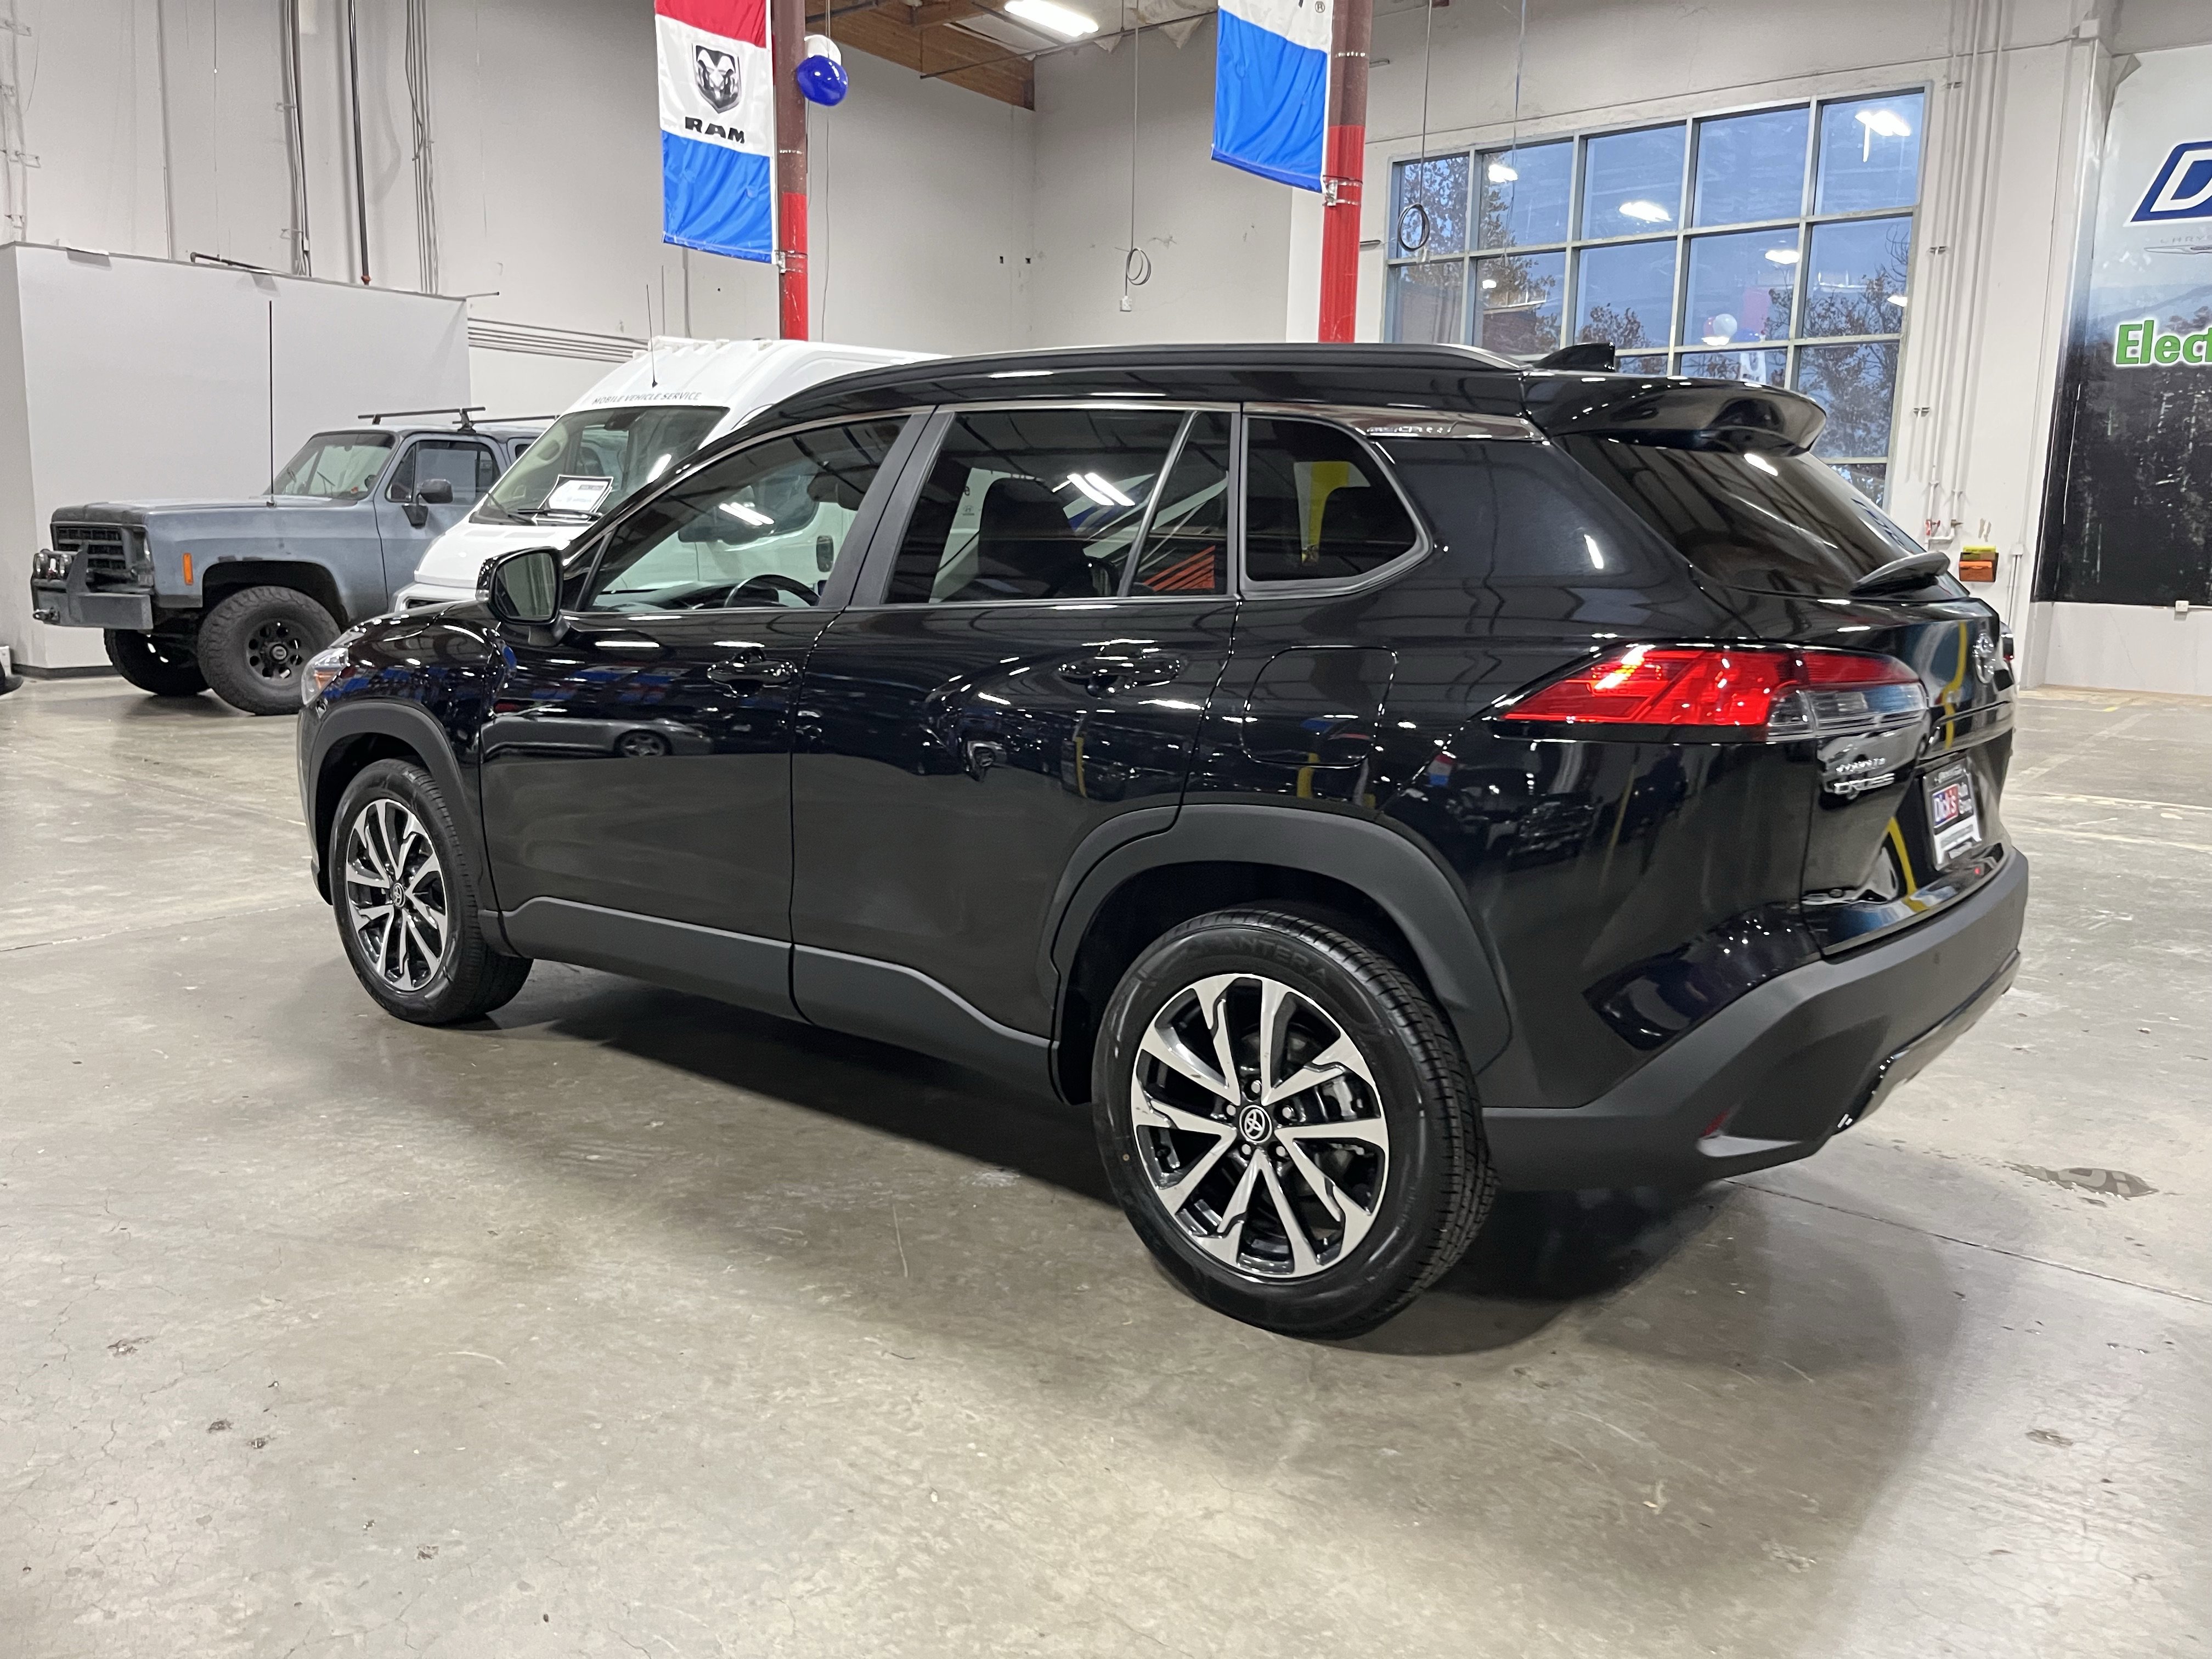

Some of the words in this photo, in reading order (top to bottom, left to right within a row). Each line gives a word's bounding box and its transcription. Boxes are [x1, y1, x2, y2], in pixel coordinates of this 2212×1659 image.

[685, 116, 745, 144] RAM
[592, 395, 624, 405] MOBILE
[625, 393, 662, 402] VEHICLE
[661, 392, 702, 401] SERVICE
